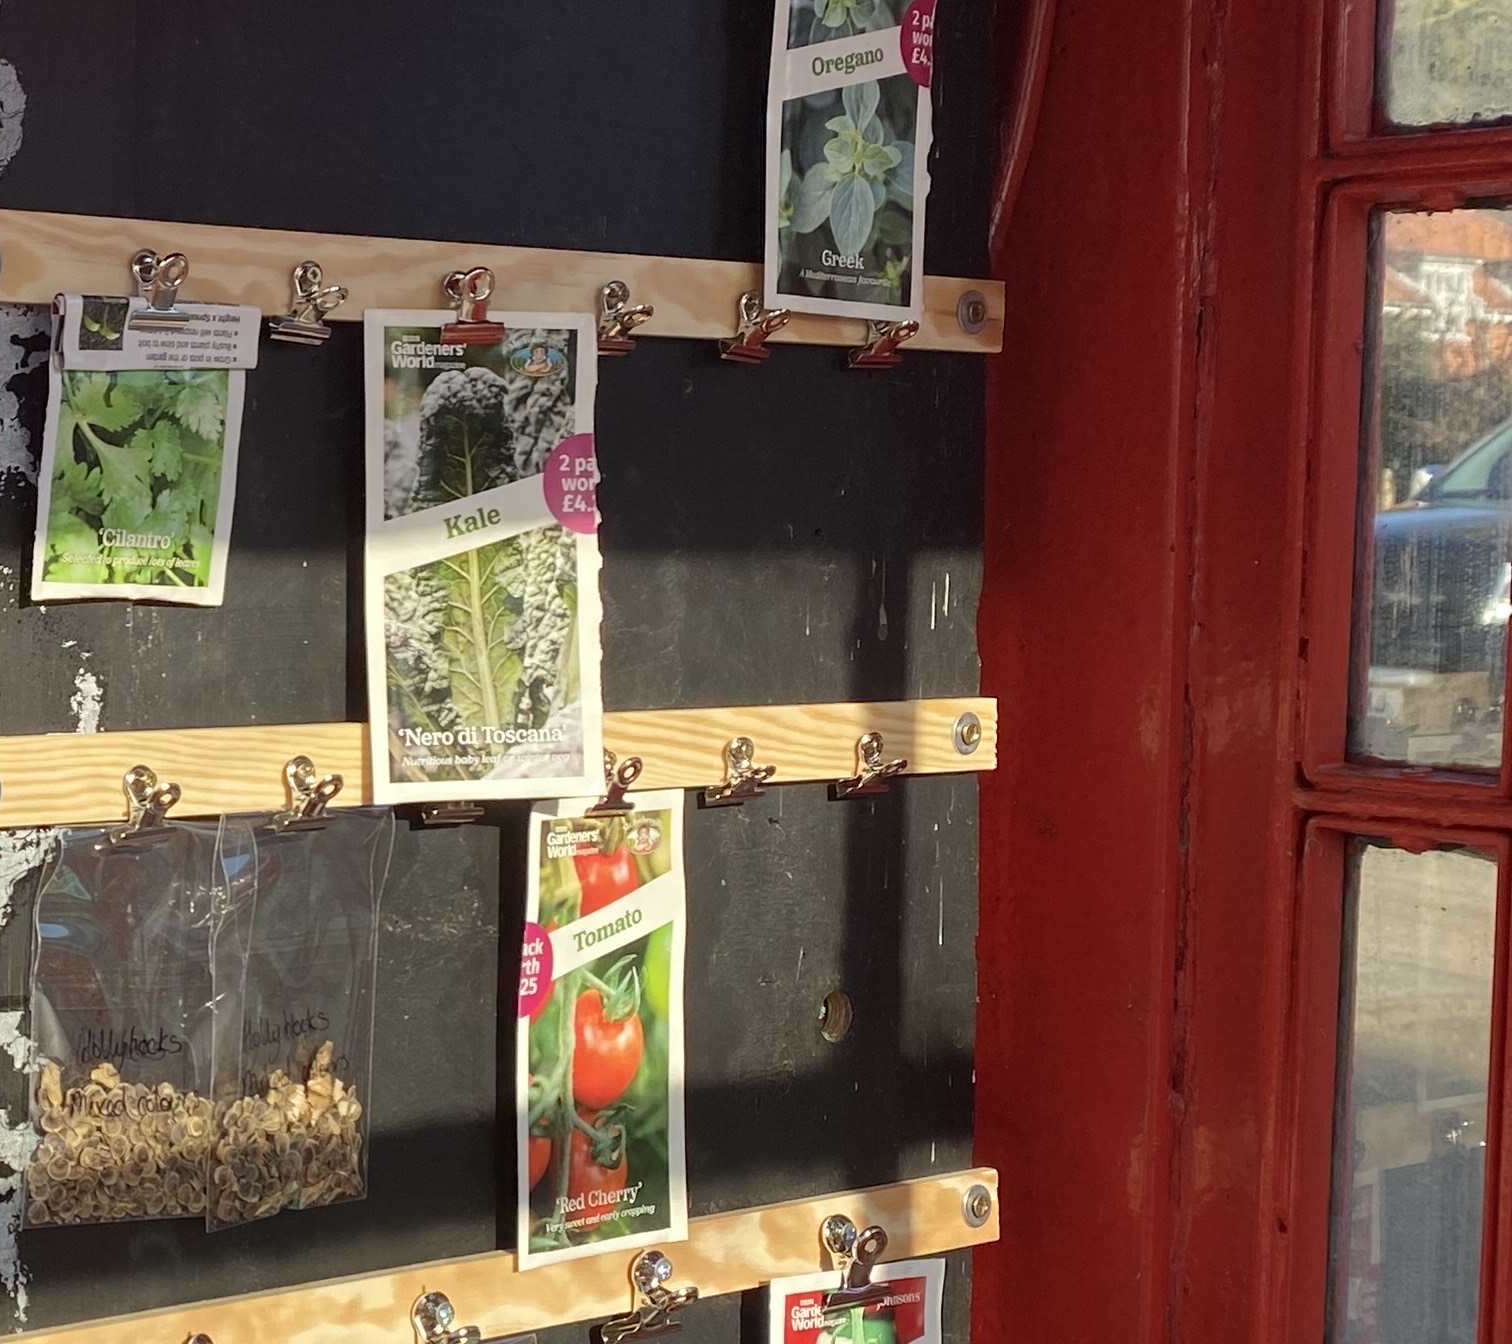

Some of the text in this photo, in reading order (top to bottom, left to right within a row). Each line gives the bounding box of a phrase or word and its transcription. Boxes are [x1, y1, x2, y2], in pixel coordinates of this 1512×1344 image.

[811, 46, 885, 76] Oregano
[821, 249, 865, 271] Greek
[391, 340, 468, 356] Gardeners'
[391, 355, 436, 369] World
[559, 455, 570, 472] 2
[443, 506, 501, 540] Kale
[458, 725, 478, 745] di
[547, 844, 577, 859] World
[573, 908, 643, 953] Tomato
[791, 1315, 825, 1331] World
